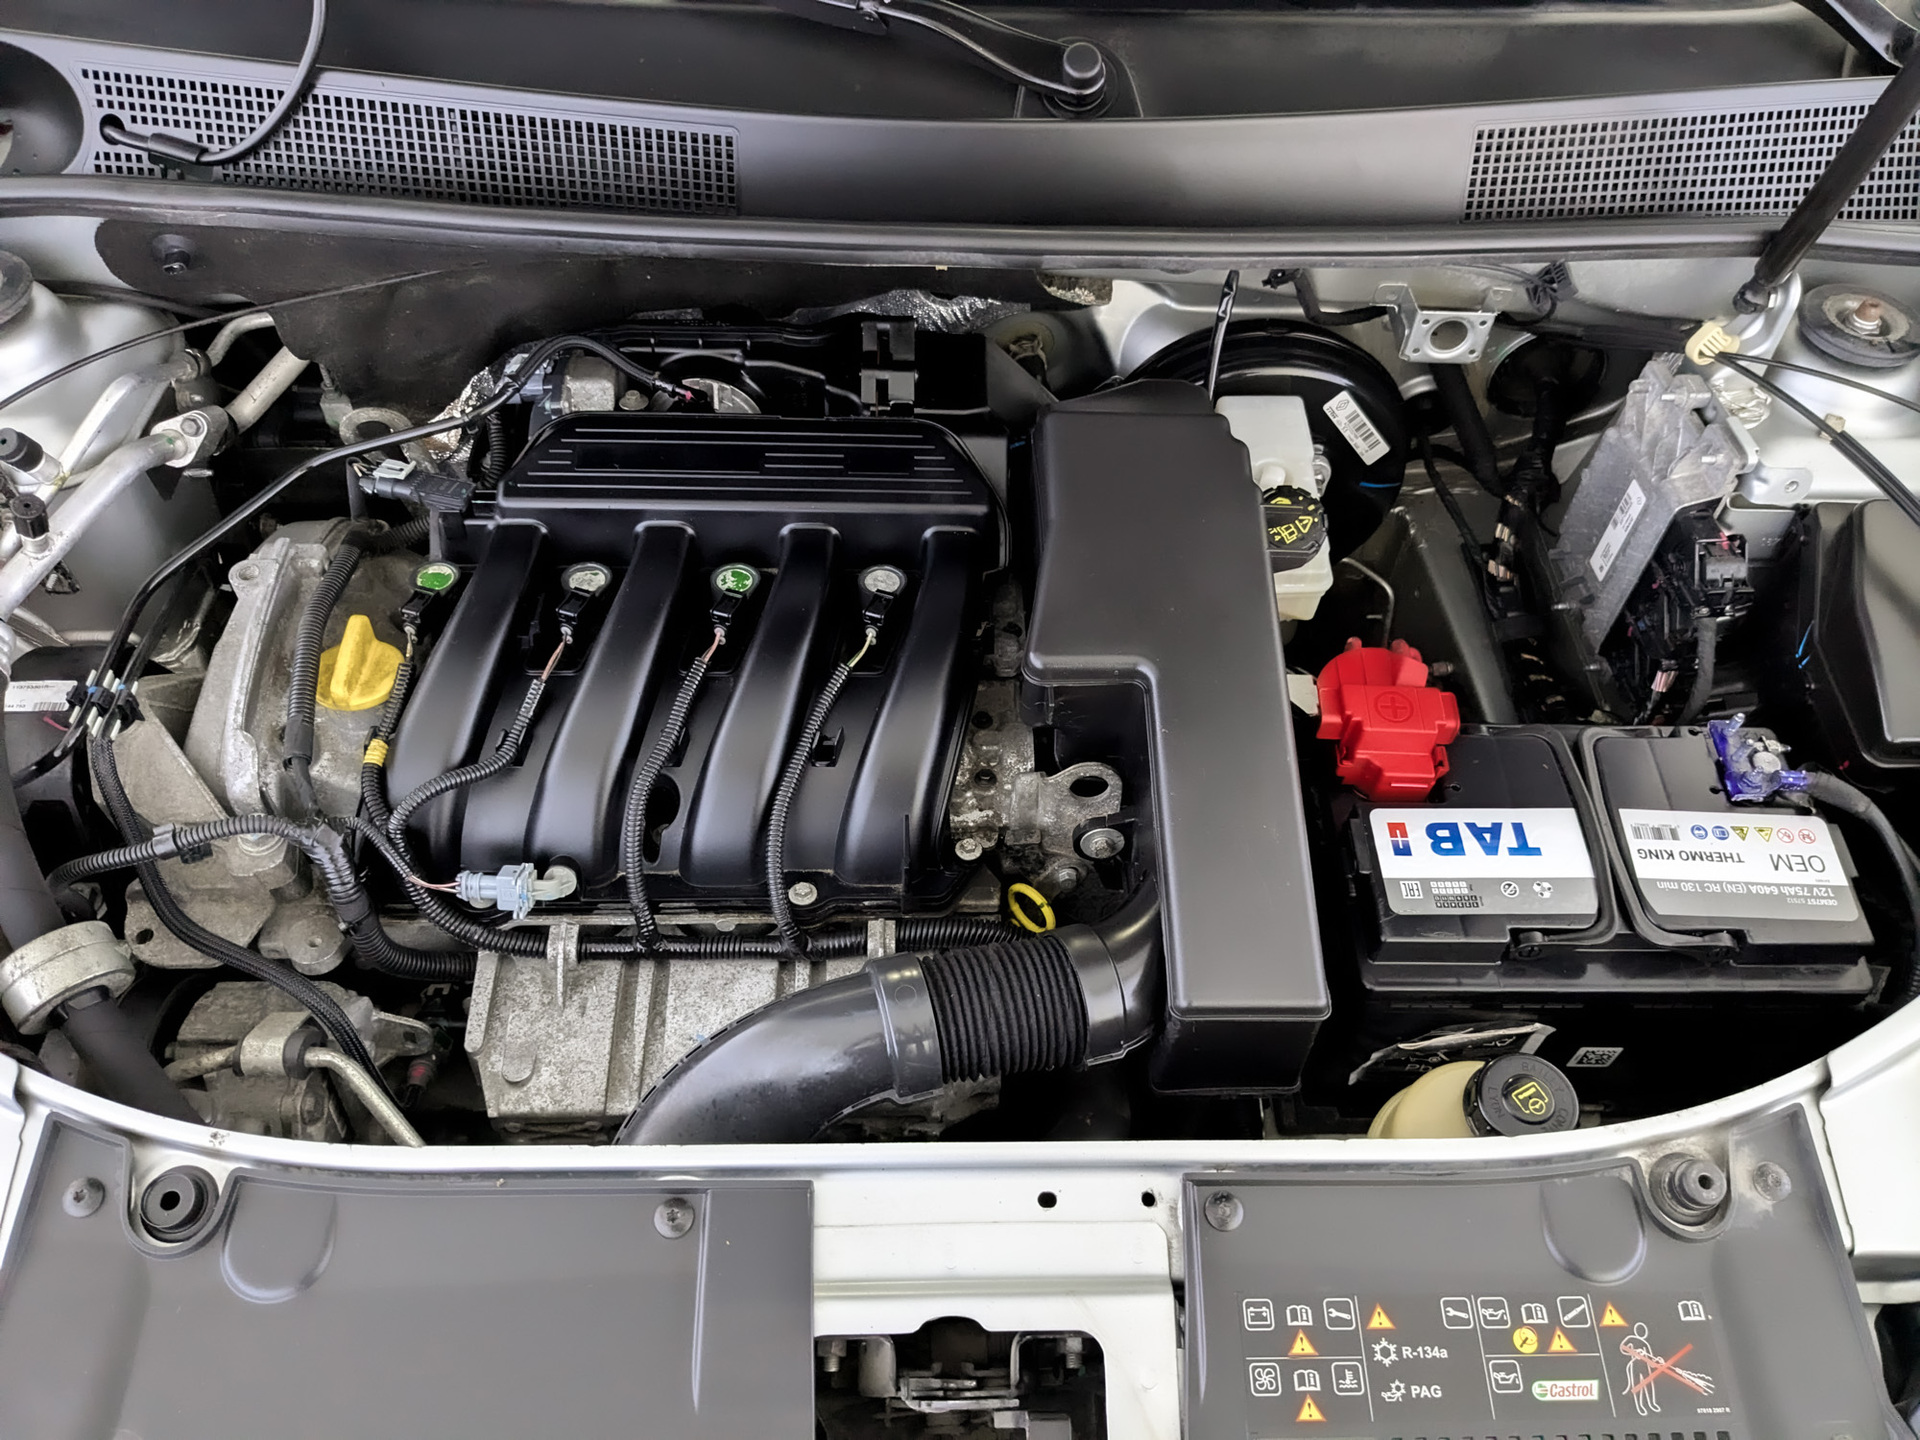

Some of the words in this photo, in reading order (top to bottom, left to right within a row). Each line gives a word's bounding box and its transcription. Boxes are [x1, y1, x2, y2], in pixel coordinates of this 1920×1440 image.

[1425, 822, 1543, 856] TAB
[1638, 848, 1674, 861] KING
[1678, 850, 1745, 863] THERMO
[1769, 853, 1826, 873] OEM
[1656, 881, 1679, 890] min
[1681, 882, 1702, 892] 130
[1706, 882, 1720, 893] RC
[1723, 882, 1747, 894] (EN)
[1749, 884, 1778, 895] 640A
[1780, 885, 1811, 896] 75Ah
[1812, 887, 1835, 897] 12V
[1404, 1063, 1433, 1072] Pb
[1402, 1346, 1448, 1359] R-134a
[1410, 1384, 1442, 1398] PAG
[1550, 1383, 1593, 1397] Castrol
